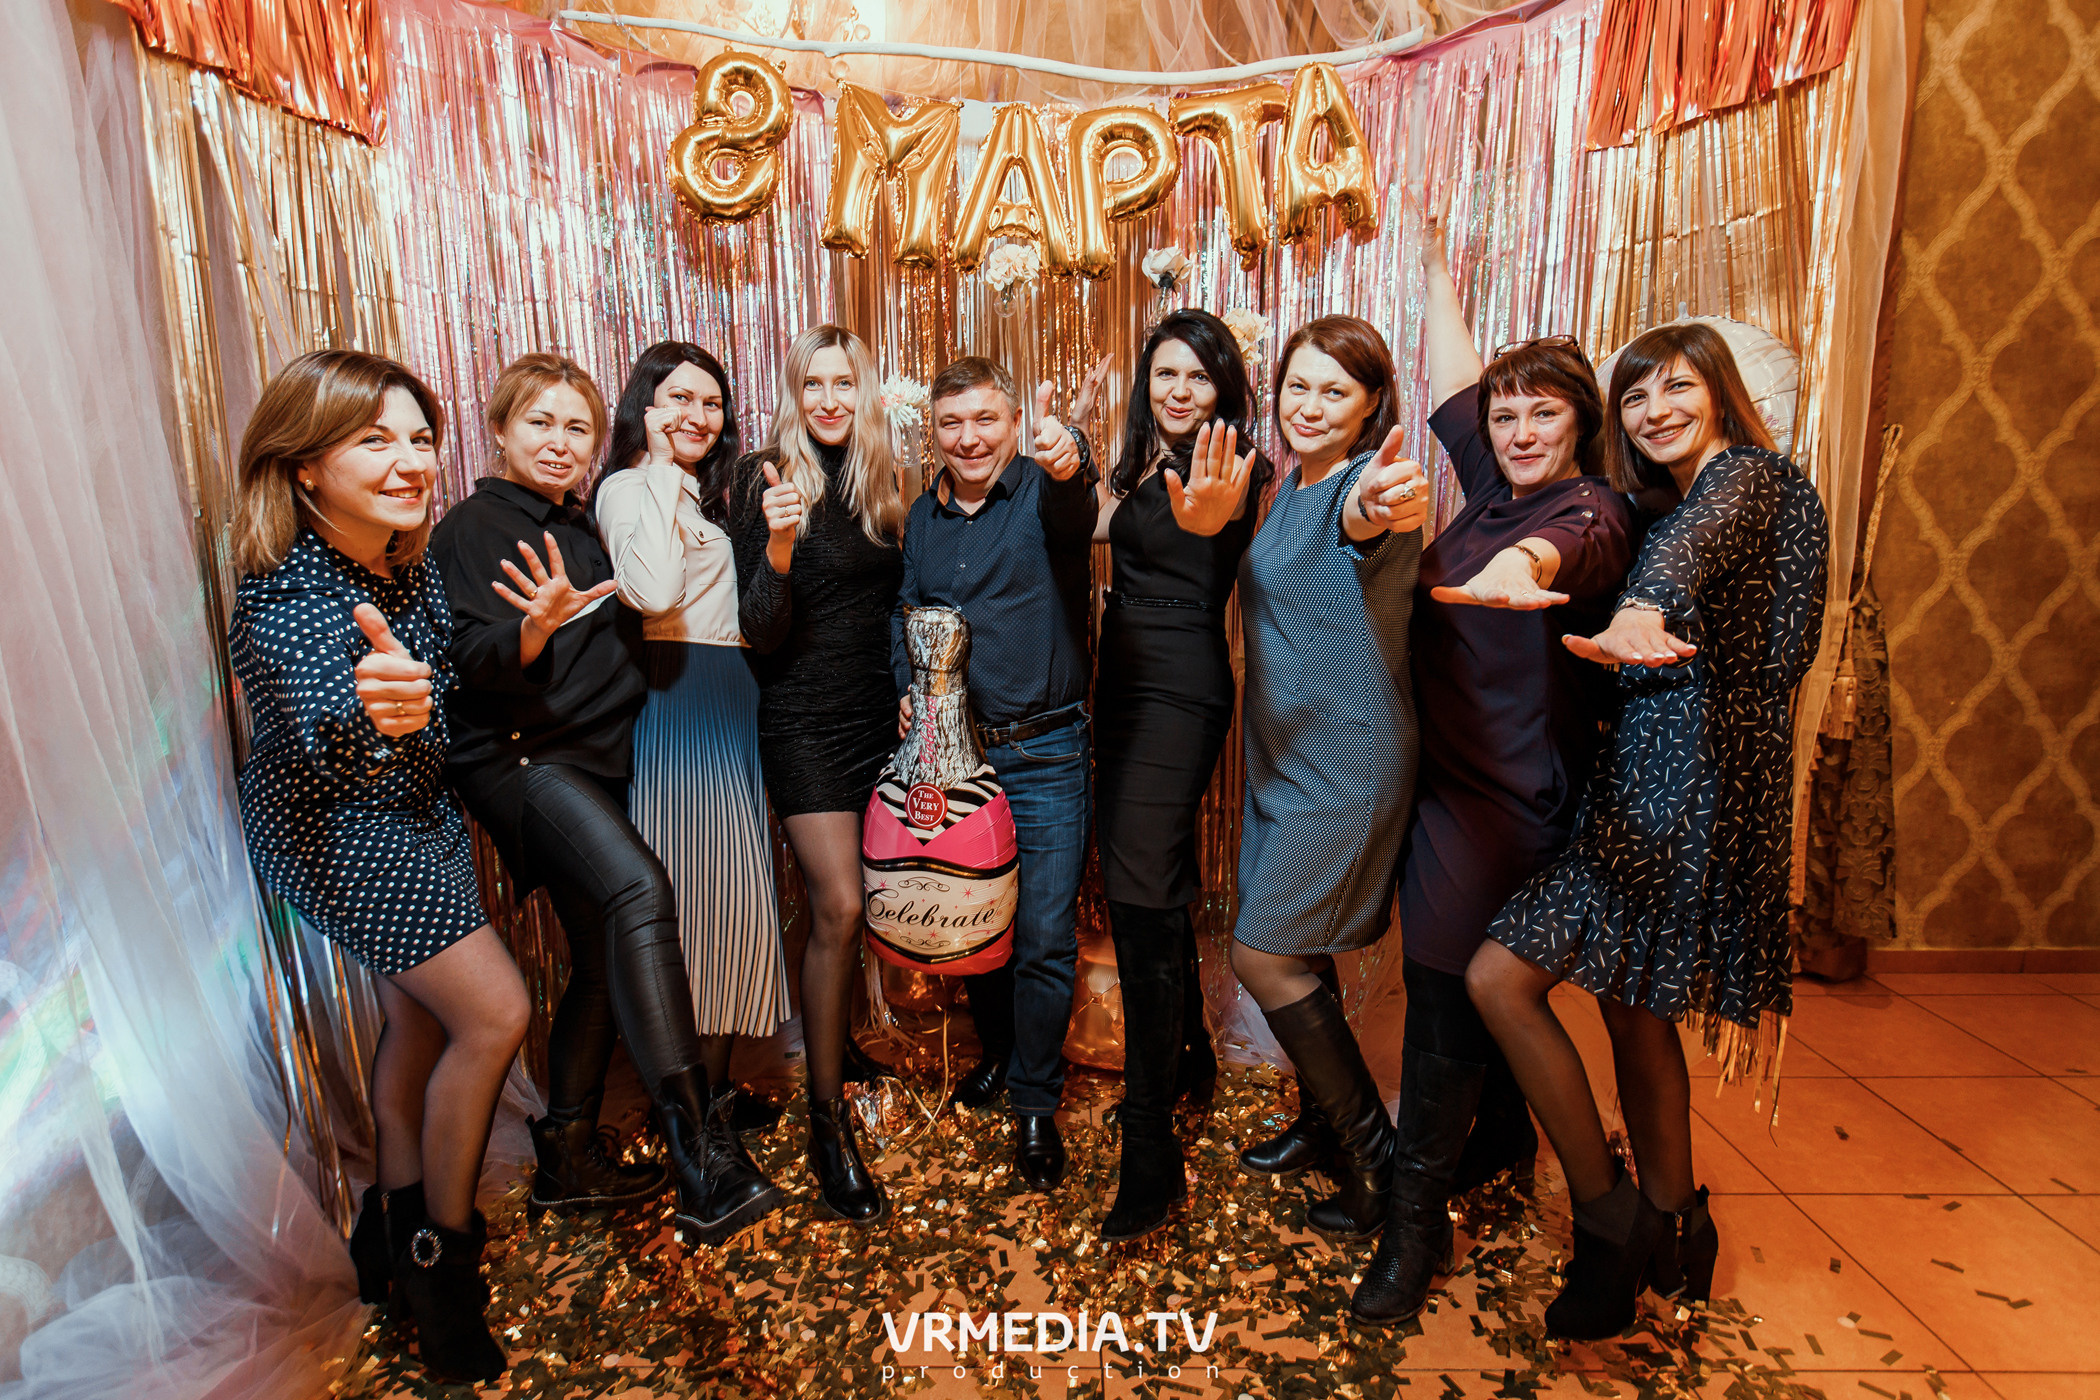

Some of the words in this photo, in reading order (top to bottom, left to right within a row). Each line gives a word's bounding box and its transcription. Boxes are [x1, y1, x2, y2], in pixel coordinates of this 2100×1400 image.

[668, 50, 793, 225] 8
[820, 62, 1379, 281] МАРТА
[919, 695, 941, 774] Celebrat
